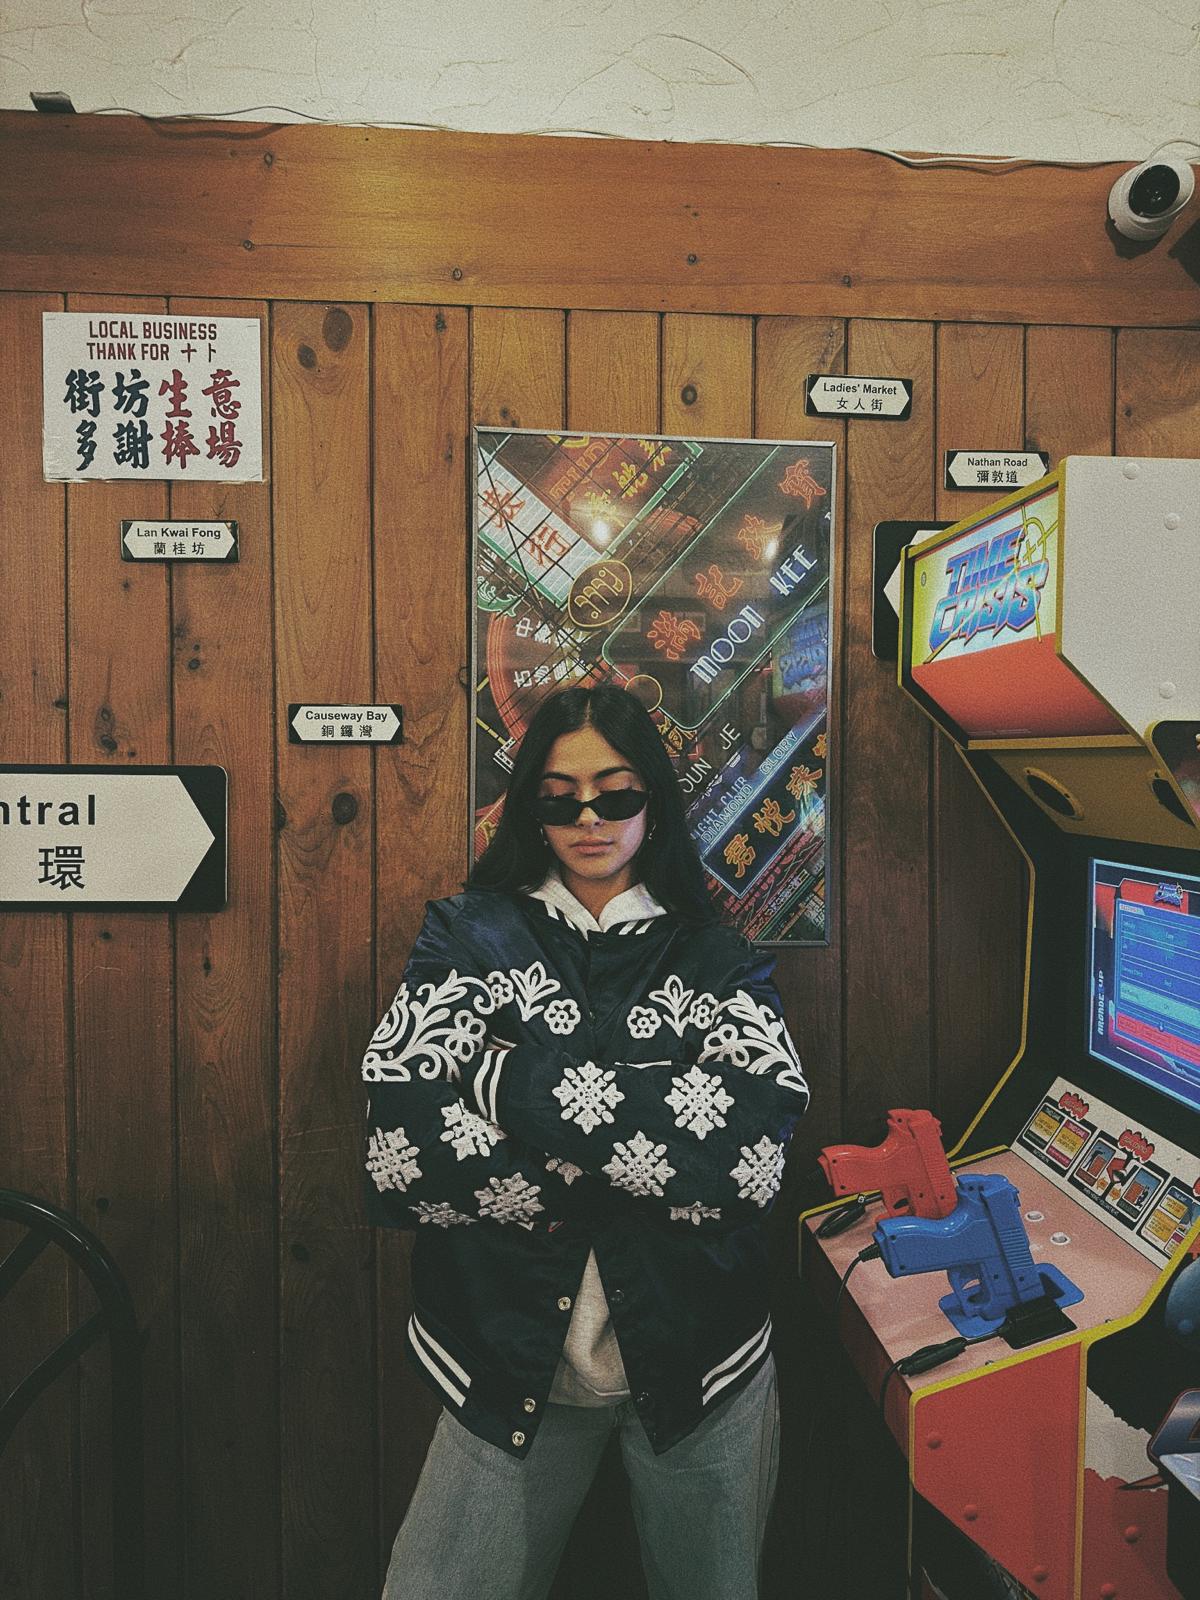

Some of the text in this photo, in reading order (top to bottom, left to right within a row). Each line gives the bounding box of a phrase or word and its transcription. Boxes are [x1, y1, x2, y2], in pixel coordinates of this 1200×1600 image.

[89, 320, 218, 341] LOCAL BUSINESS
[87, 342, 170, 361] THANK FOR
[823, 382, 897, 395] Ladies' Market
[836, 397, 883, 412] 女人街
[967, 458, 1028, 467] Nathan Road
[976, 470, 1018, 484] 彌敦道
[136, 527, 221, 540] Lan Kwai Fong
[153, 541, 206, 556] 蘭桂坊
[945, 524, 1026, 597] TIME
[928, 558, 1049, 653] CRISIS
[690, 604, 765, 684] MOON
[770, 544, 818, 597] KEE
[305, 710, 388, 722] Causeway Bay
[321, 724, 373, 738] 銅鑼灣
[701, 784, 753, 845] DIAMOND
[758, 730, 798, 776] GLORY
[37, 846, 86, 891] 環
